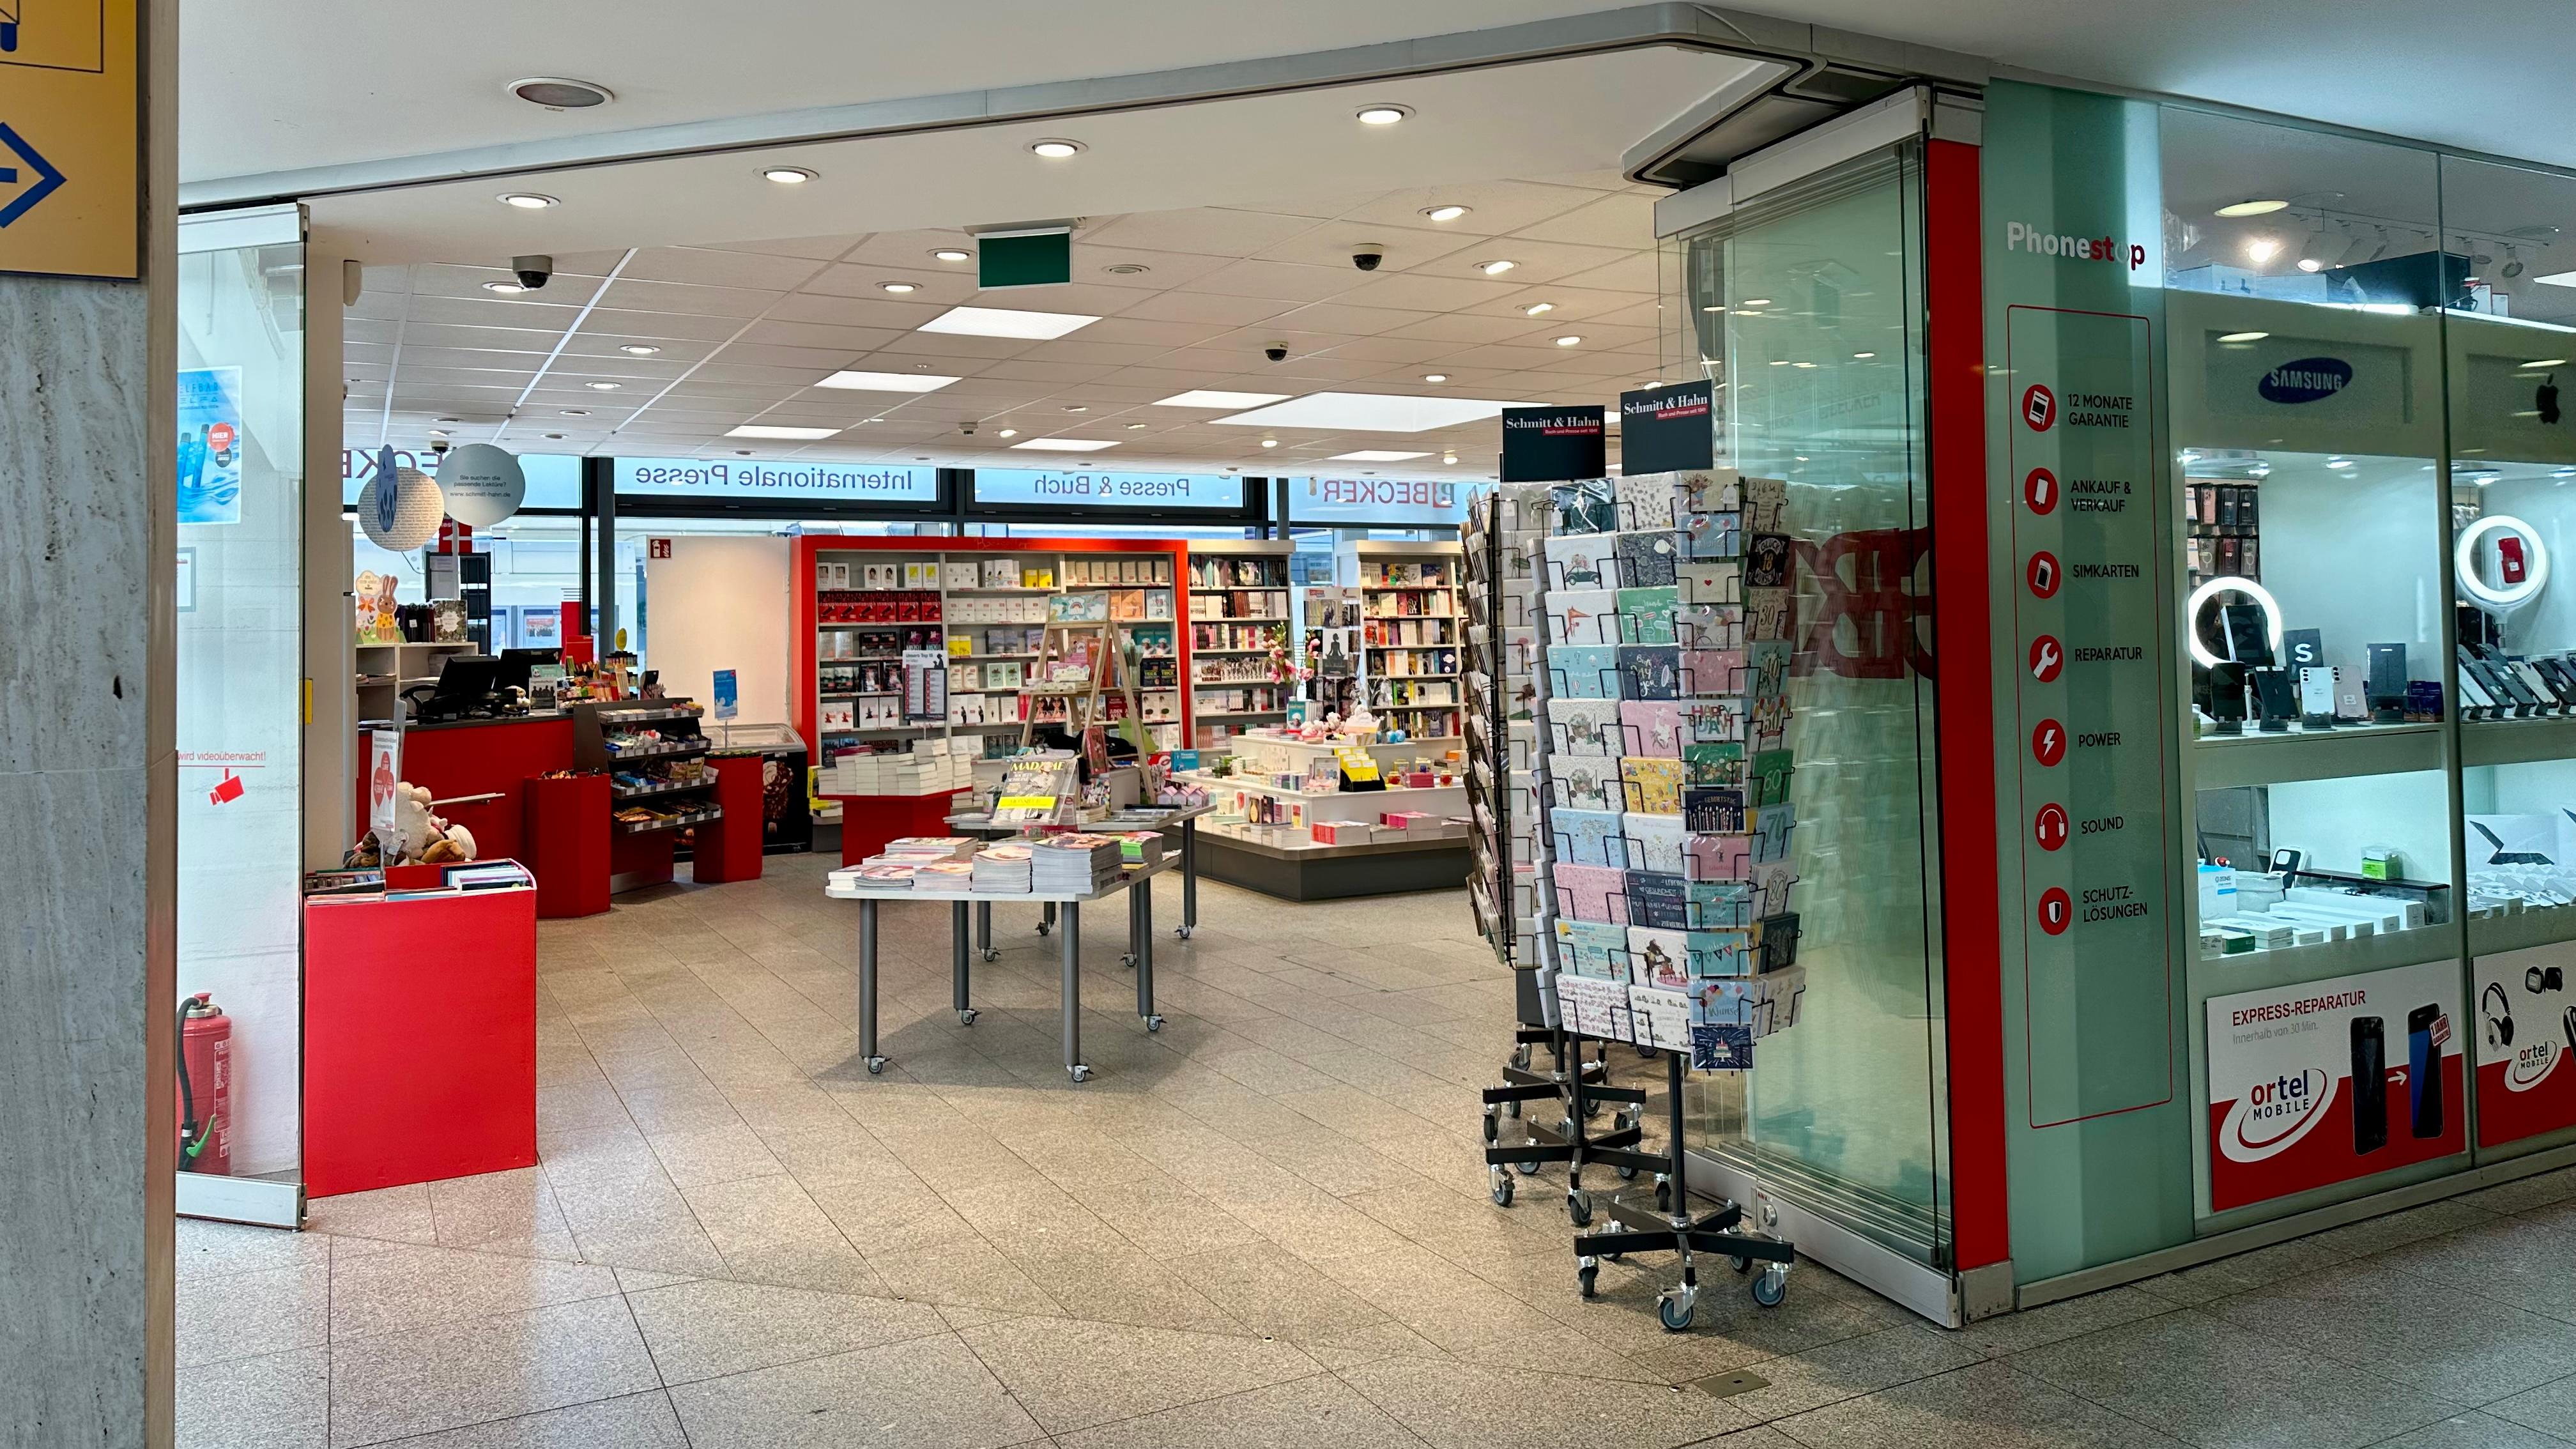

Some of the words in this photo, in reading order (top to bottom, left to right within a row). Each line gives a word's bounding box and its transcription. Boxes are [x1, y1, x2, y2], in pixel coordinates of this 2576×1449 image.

[2007, 221, 2145, 271] Phonestop
[2270, 368, 2342, 390] SAMSUNG
[1623, 401, 1664, 416] Schmitt
[1666, 397, 1676, 409] &
[1677, 394, 1708, 408] Hahn
[2067, 394, 2080, 407] 12
[2083, 394, 2133, 410] MONATE
[1506, 417, 1551, 429] Schmitt
[1554, 417, 1565, 428] &
[1567, 416, 1600, 427] Hahn
[2069, 411, 2129, 428] GARANTIE
[2070, 480, 2120, 494] ANKAUF
[2124, 481, 2131, 494] &
[2071, 498, 2126, 512] VERKAUF
[1762, 551, 1774, 571] 18
[2073, 564, 2140, 578] SIMKARTEN
[1760, 605, 1775, 625] 30
[2074, 647, 2142, 662] REPARATUR
[2294, 643, 2313, 663] S
[1691, 705, 1733, 717] HAPPY
[1763, 713, 1780, 732] 50
[2078, 732, 2121, 747] POWER
[177, 751, 194, 762] wird
[197, 751, 266, 762] videoüberwacht!
[1763, 769, 1782, 792] 60
[1766, 812, 1788, 843] 70
[2081, 816, 2124, 834] SOUND
[1770, 879, 1785, 901] 80
[2083, 885, 2134, 904] SCHUTZ-
[2083, 901, 2148, 923] LÖSUNGEN
[2232, 990, 2366, 1027] EXPRESS-REPARATUR
[2233, 1025, 2272, 1045] Innerhalb
[2290, 1022, 2301, 1034] 30
[2519, 1041, 2549, 1061] ortel
[2520, 1057, 2549, 1069] MOBILE
[2251, 1070, 2310, 1106] ortel
[2253, 1098, 2310, 1121] MOBILE
